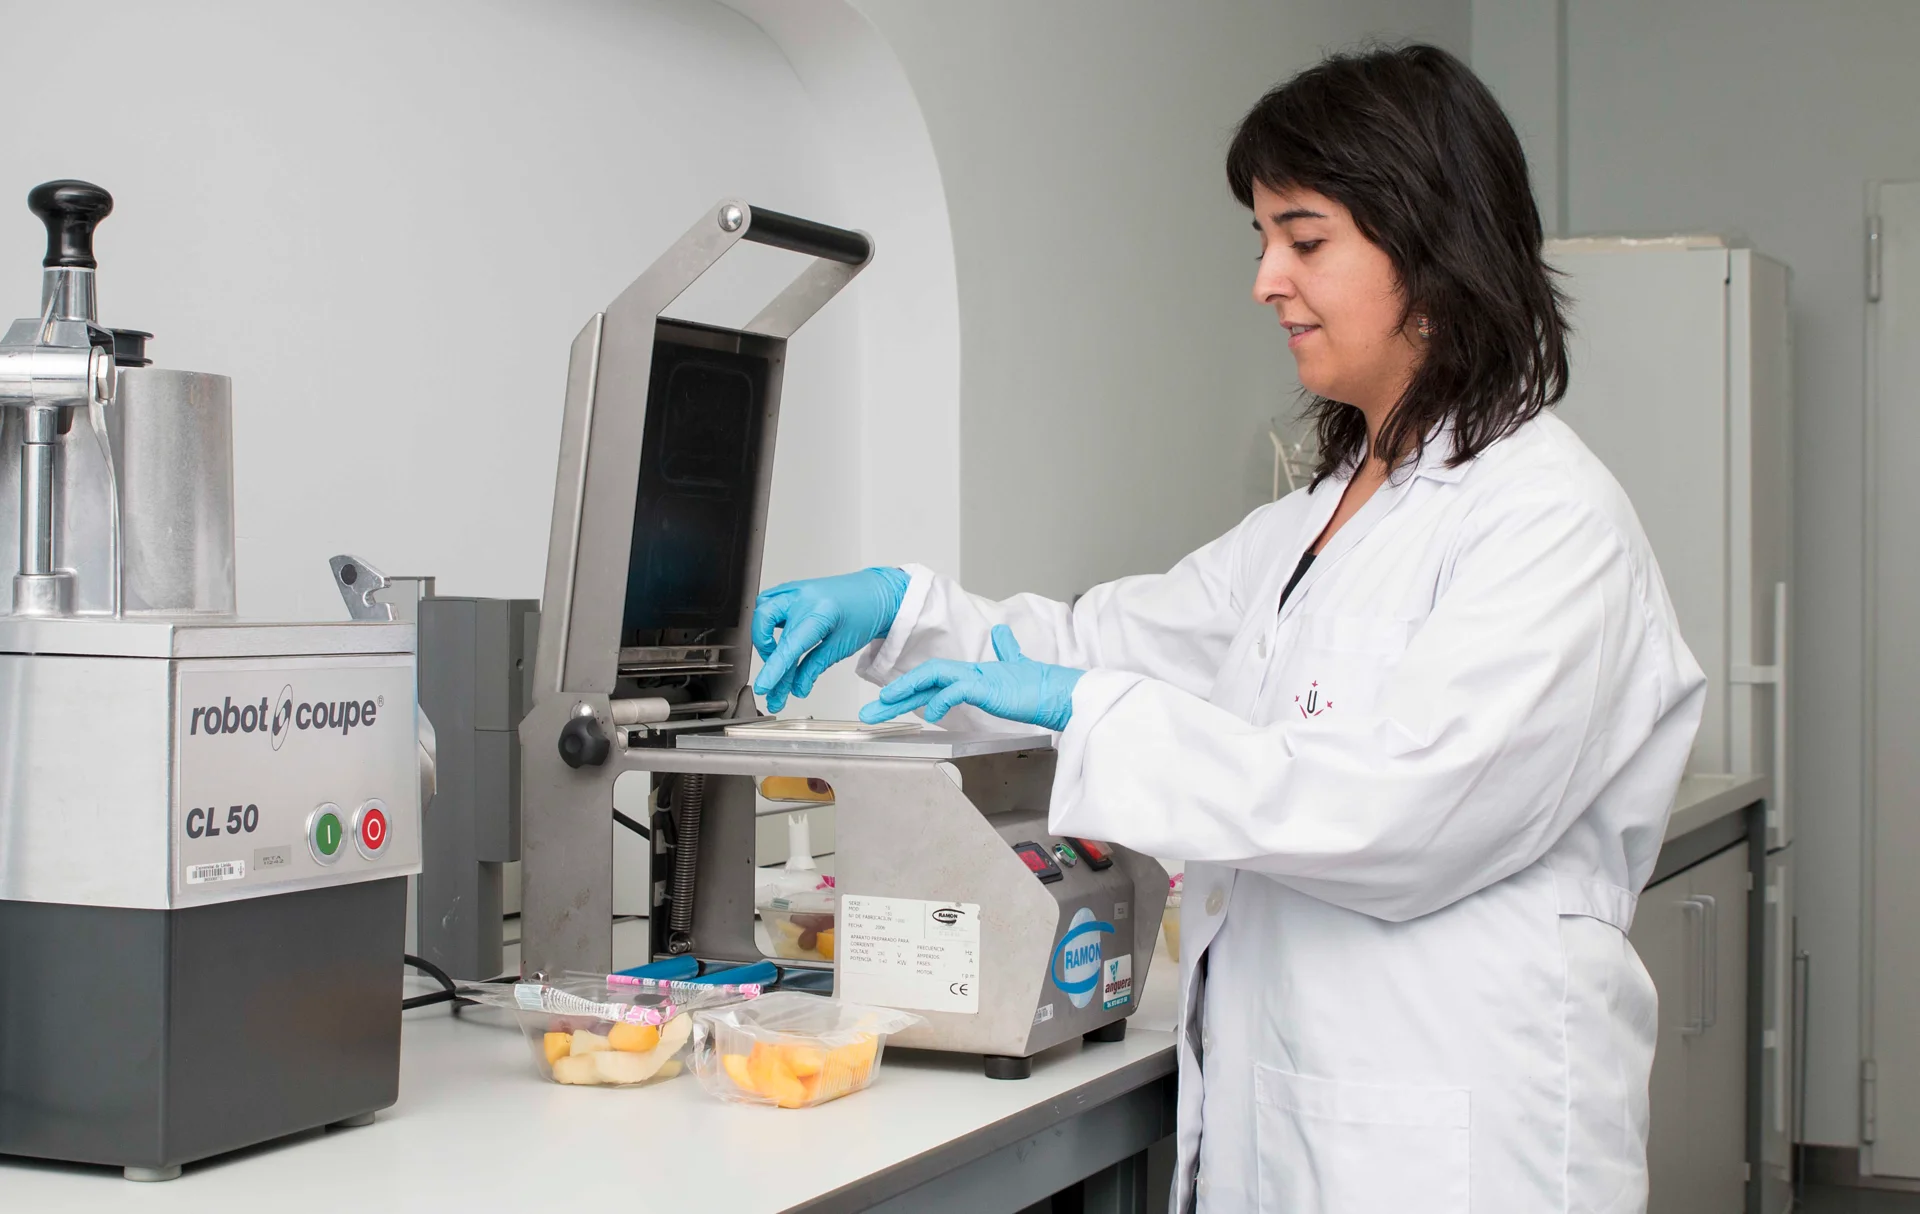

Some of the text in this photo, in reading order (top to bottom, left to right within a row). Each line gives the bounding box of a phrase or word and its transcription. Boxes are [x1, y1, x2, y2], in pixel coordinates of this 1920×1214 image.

[190, 696, 268, 735] robot
[186, 804, 259, 839] CL 50
[1105, 977, 1131, 995] anguera
